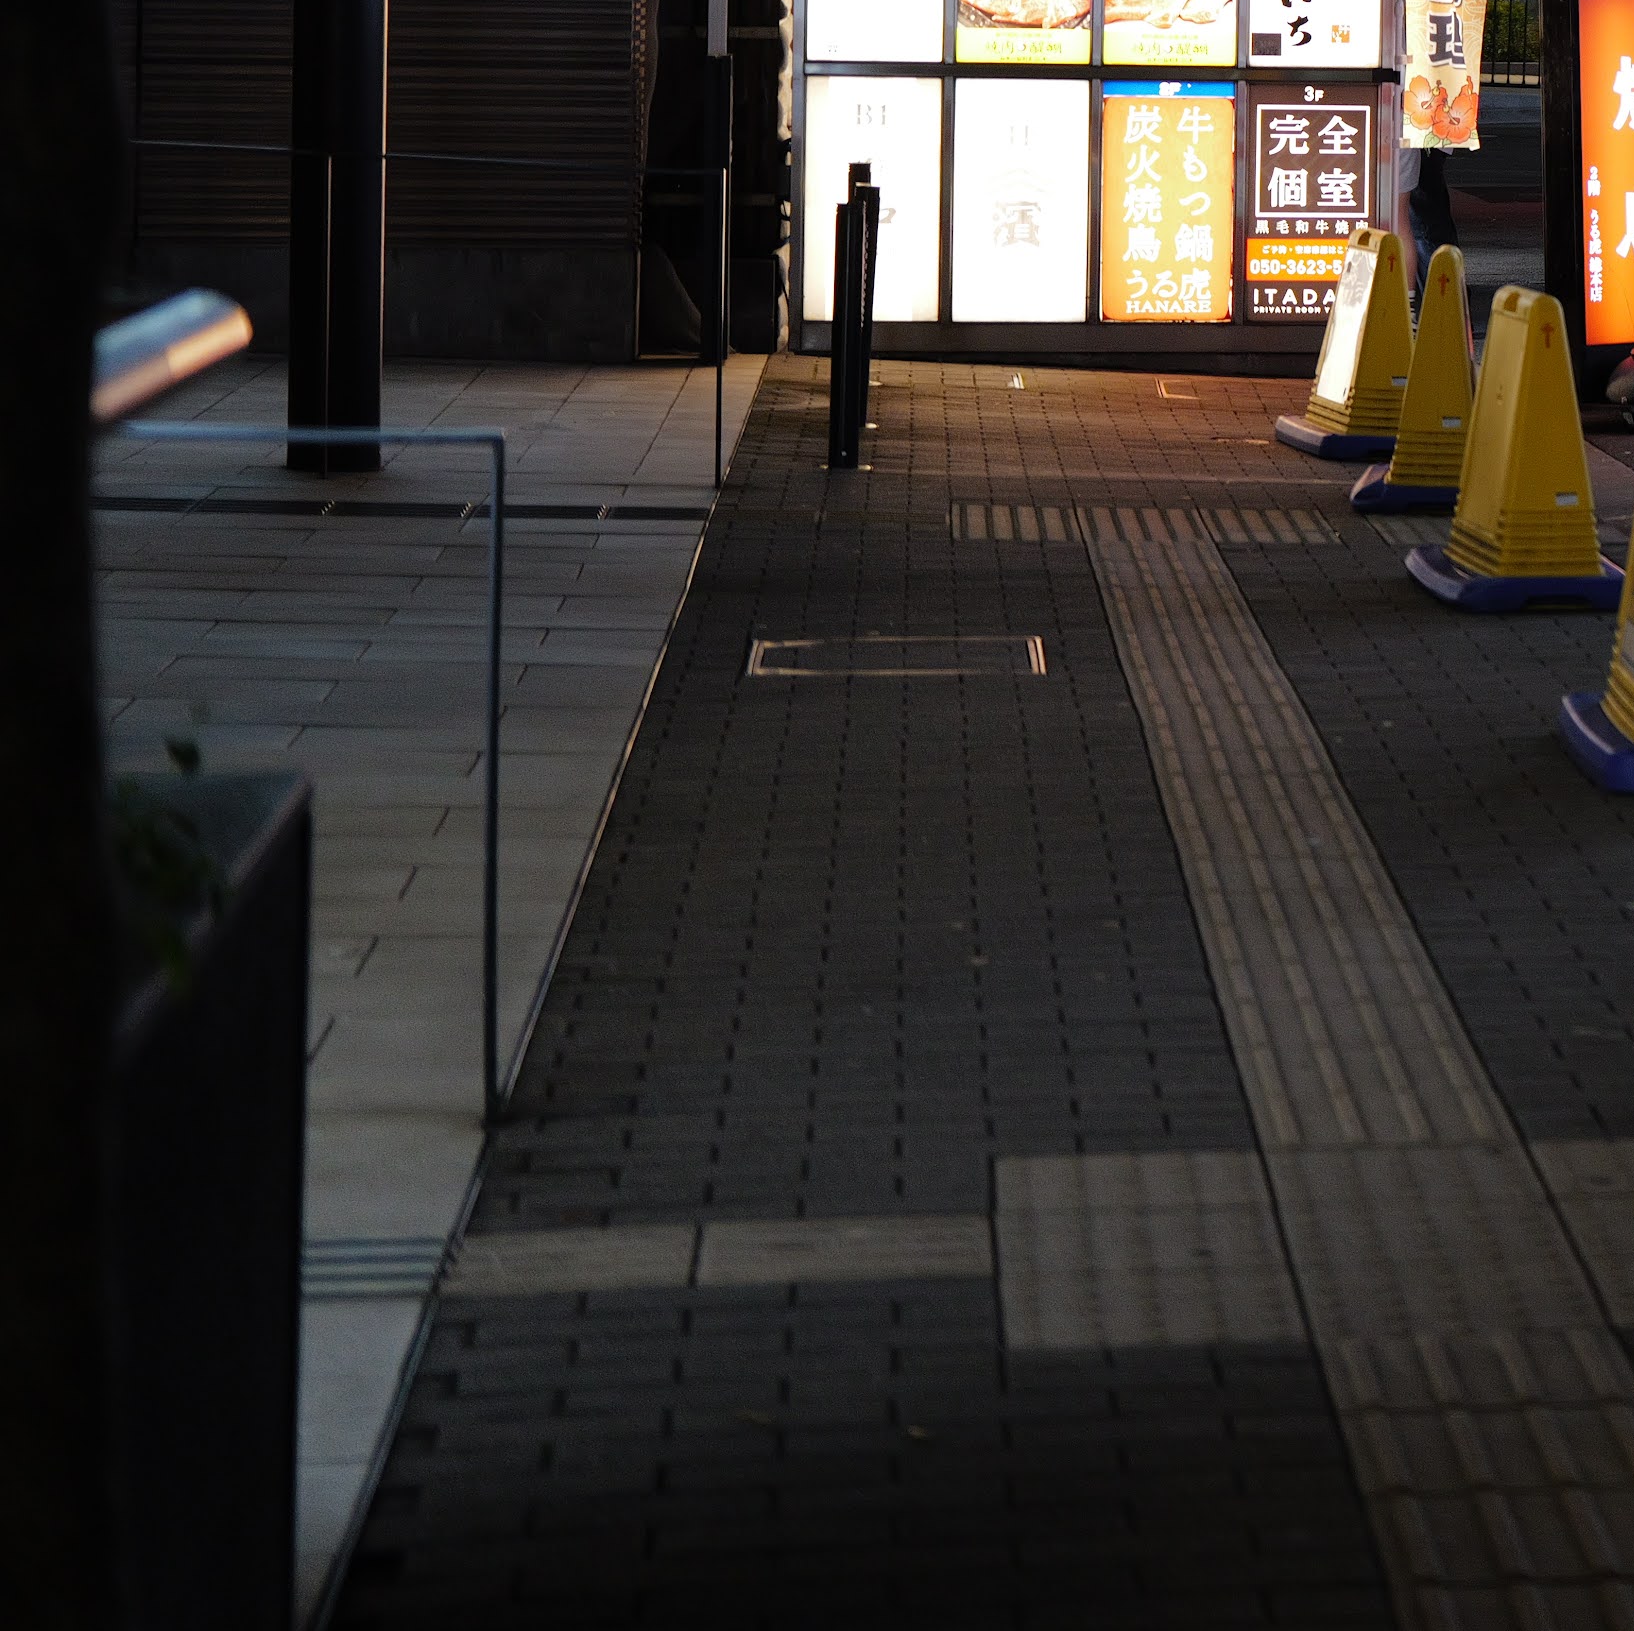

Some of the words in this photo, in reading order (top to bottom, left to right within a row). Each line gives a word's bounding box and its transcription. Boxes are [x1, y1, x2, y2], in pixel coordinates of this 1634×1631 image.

[1304, 86, 1324, 102] 3F
[1268, 115, 1359, 156] 完全
[1123, 105, 1162, 262] 炭火焼鳥
[1175, 106, 1214, 263] 牛もつ鍋
[1267, 167, 1358, 208] 個室
[1255, 220, 1369, 235] 黒毛和牛焼肉
[1262, 245, 1348, 255] ご予約・空席確認はこ
[1250, 259, 1342, 275] 050-3623-5
[1127, 268, 1211, 300] うる虎
[1253, 288, 1336, 305] ITADA
[1126, 300, 1211, 313] HANARE
[1253, 306, 1292, 314] PRIVATE
[1295, 306, 1321, 314] ROOM
